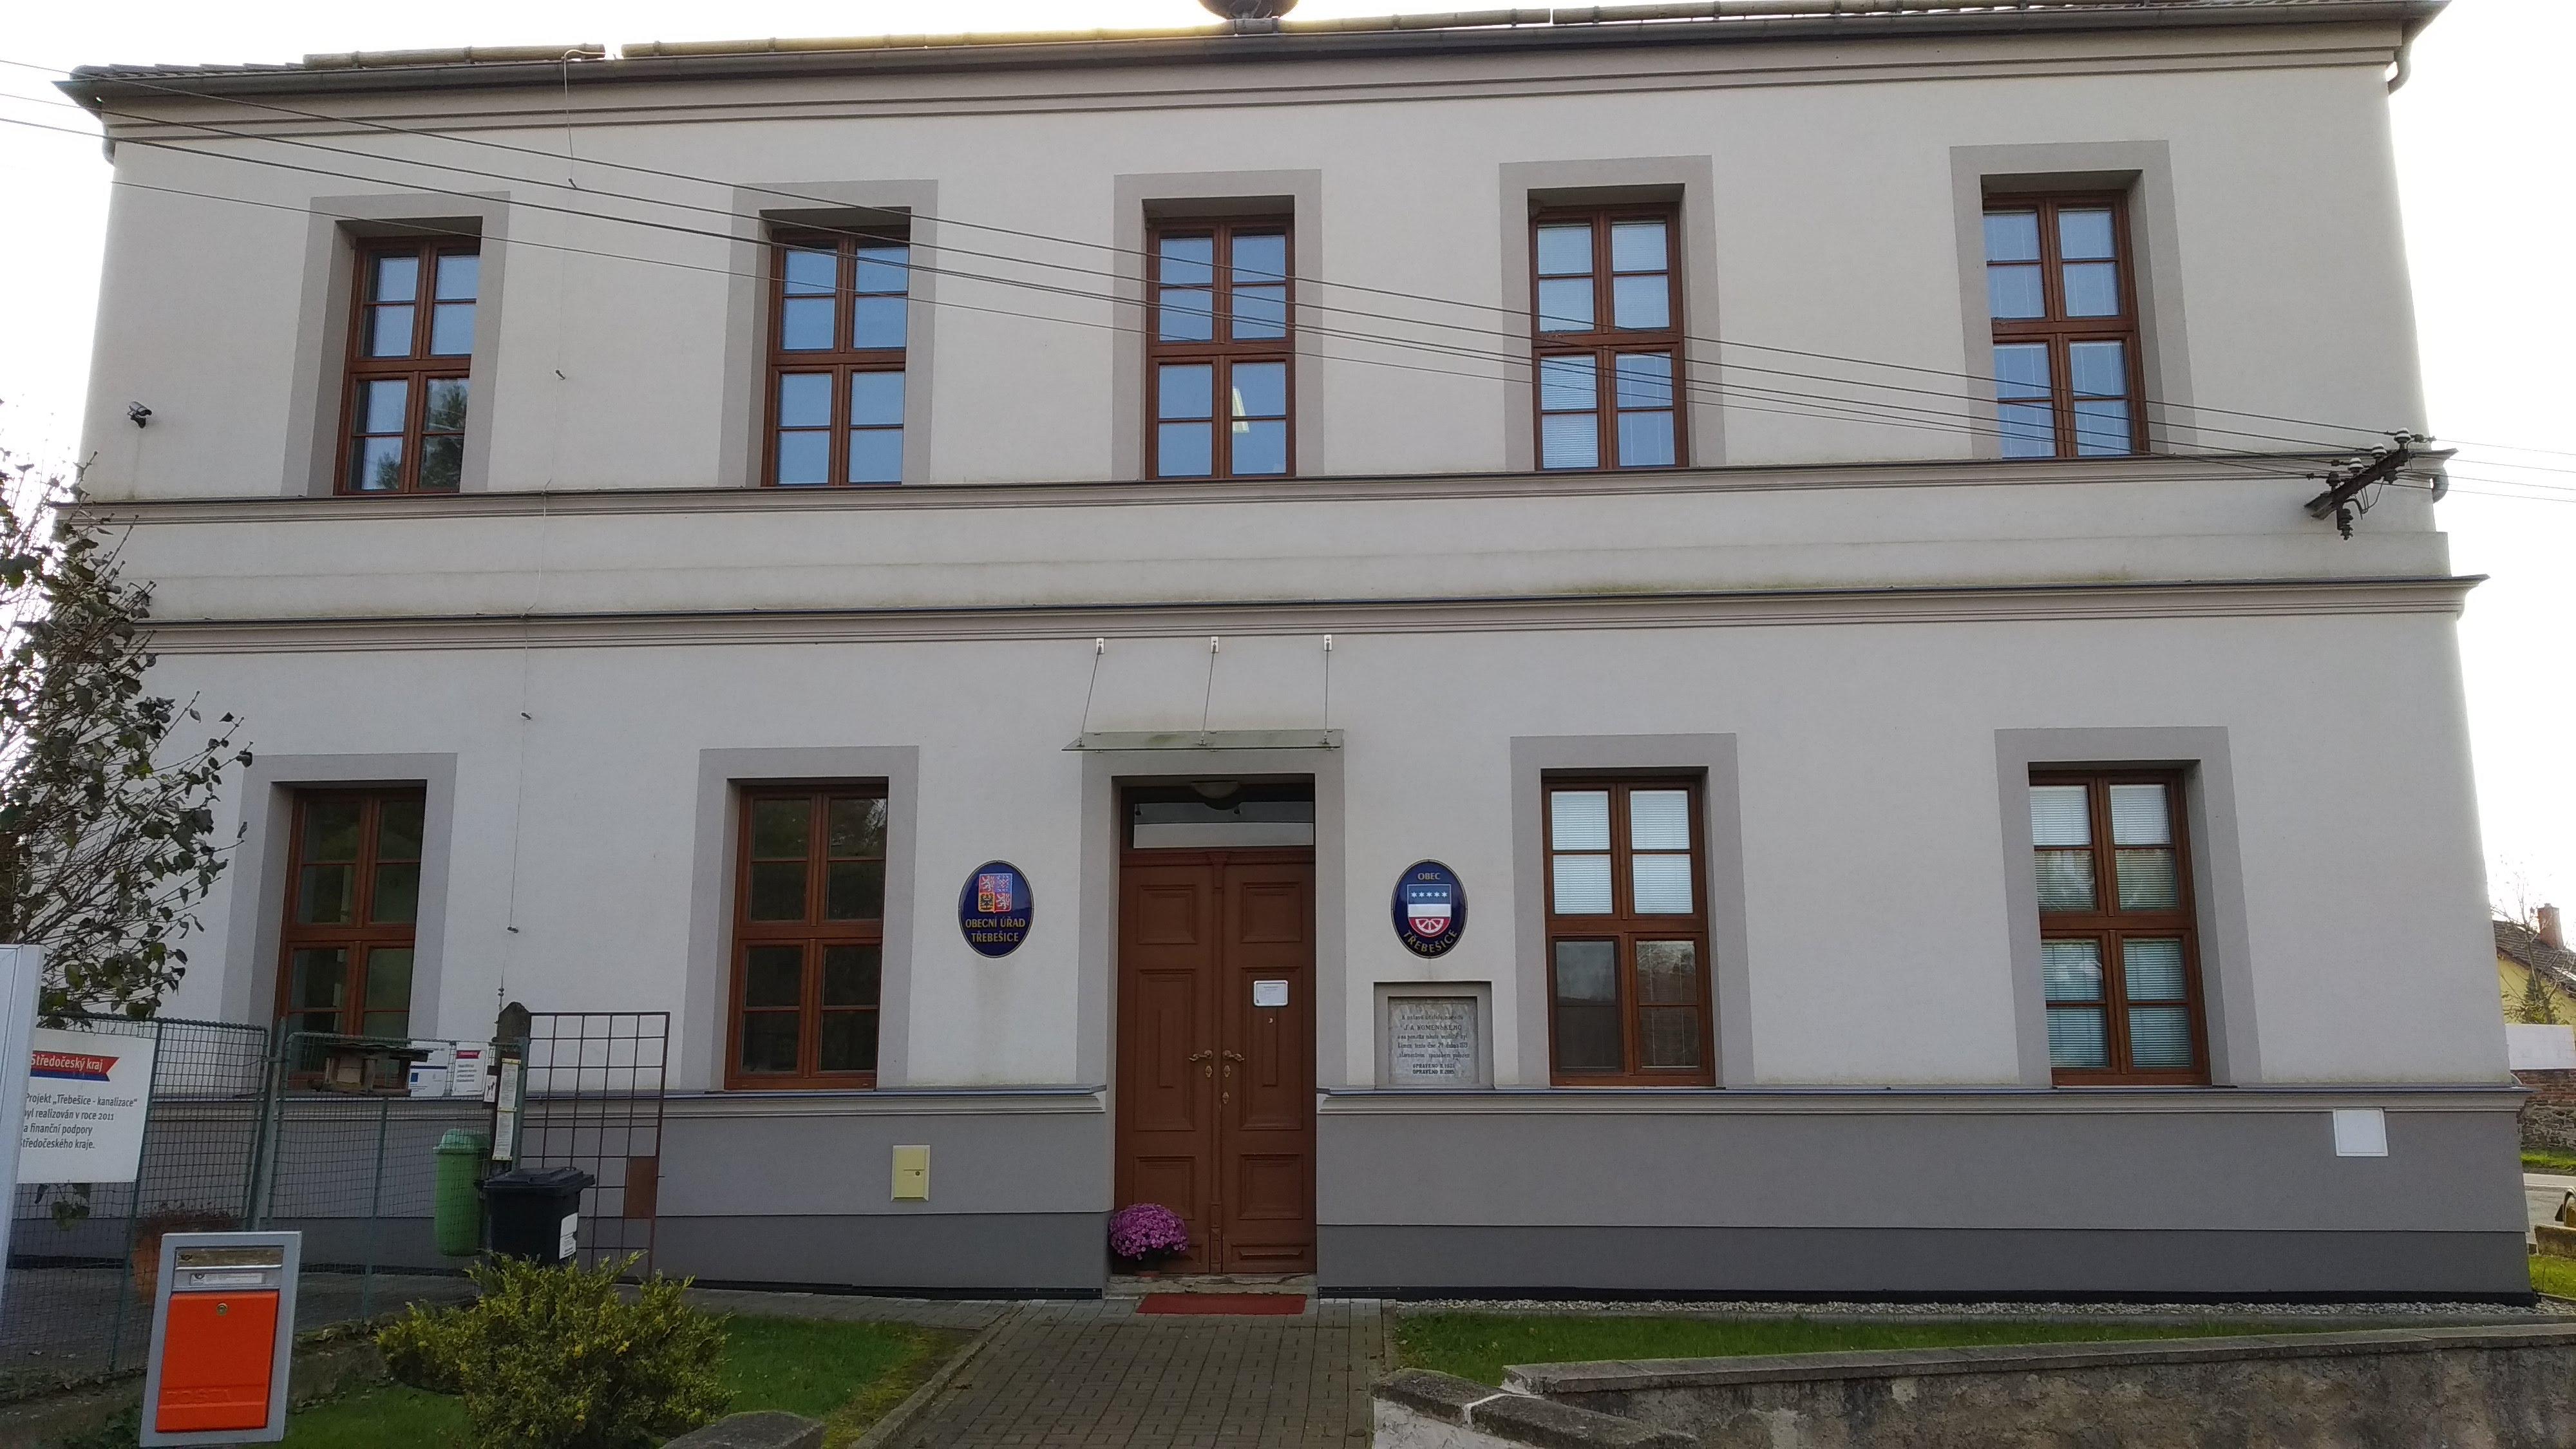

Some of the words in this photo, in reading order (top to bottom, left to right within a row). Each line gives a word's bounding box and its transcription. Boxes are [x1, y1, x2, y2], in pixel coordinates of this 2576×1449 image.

[1417, 872, 1442, 880] OBEC
[965, 916, 998, 928] OBECNÍ
[999, 915, 1026, 928] ÚŘAD
[971, 931, 1019, 942] TŘEBEŠICE
[1403, 929, 1458, 953] TŘEBEŠICE
[31, 1054, 85, 1072] Středočeský
[86, 1058, 104, 1073] kraj
[24, 1108, 34, 1120] yl
[35, 1108, 74, 1119] realizován
[81, 1112, 97, 1120] roce
[97, 1112, 114, 1121] 2011
[30, 1122, 62, 1133] finanční
[61, 1124, 93, 1137] podpory
[21, 1137, 73, 1148] tředočeského
[74, 1139, 96, 1151] kraje.
